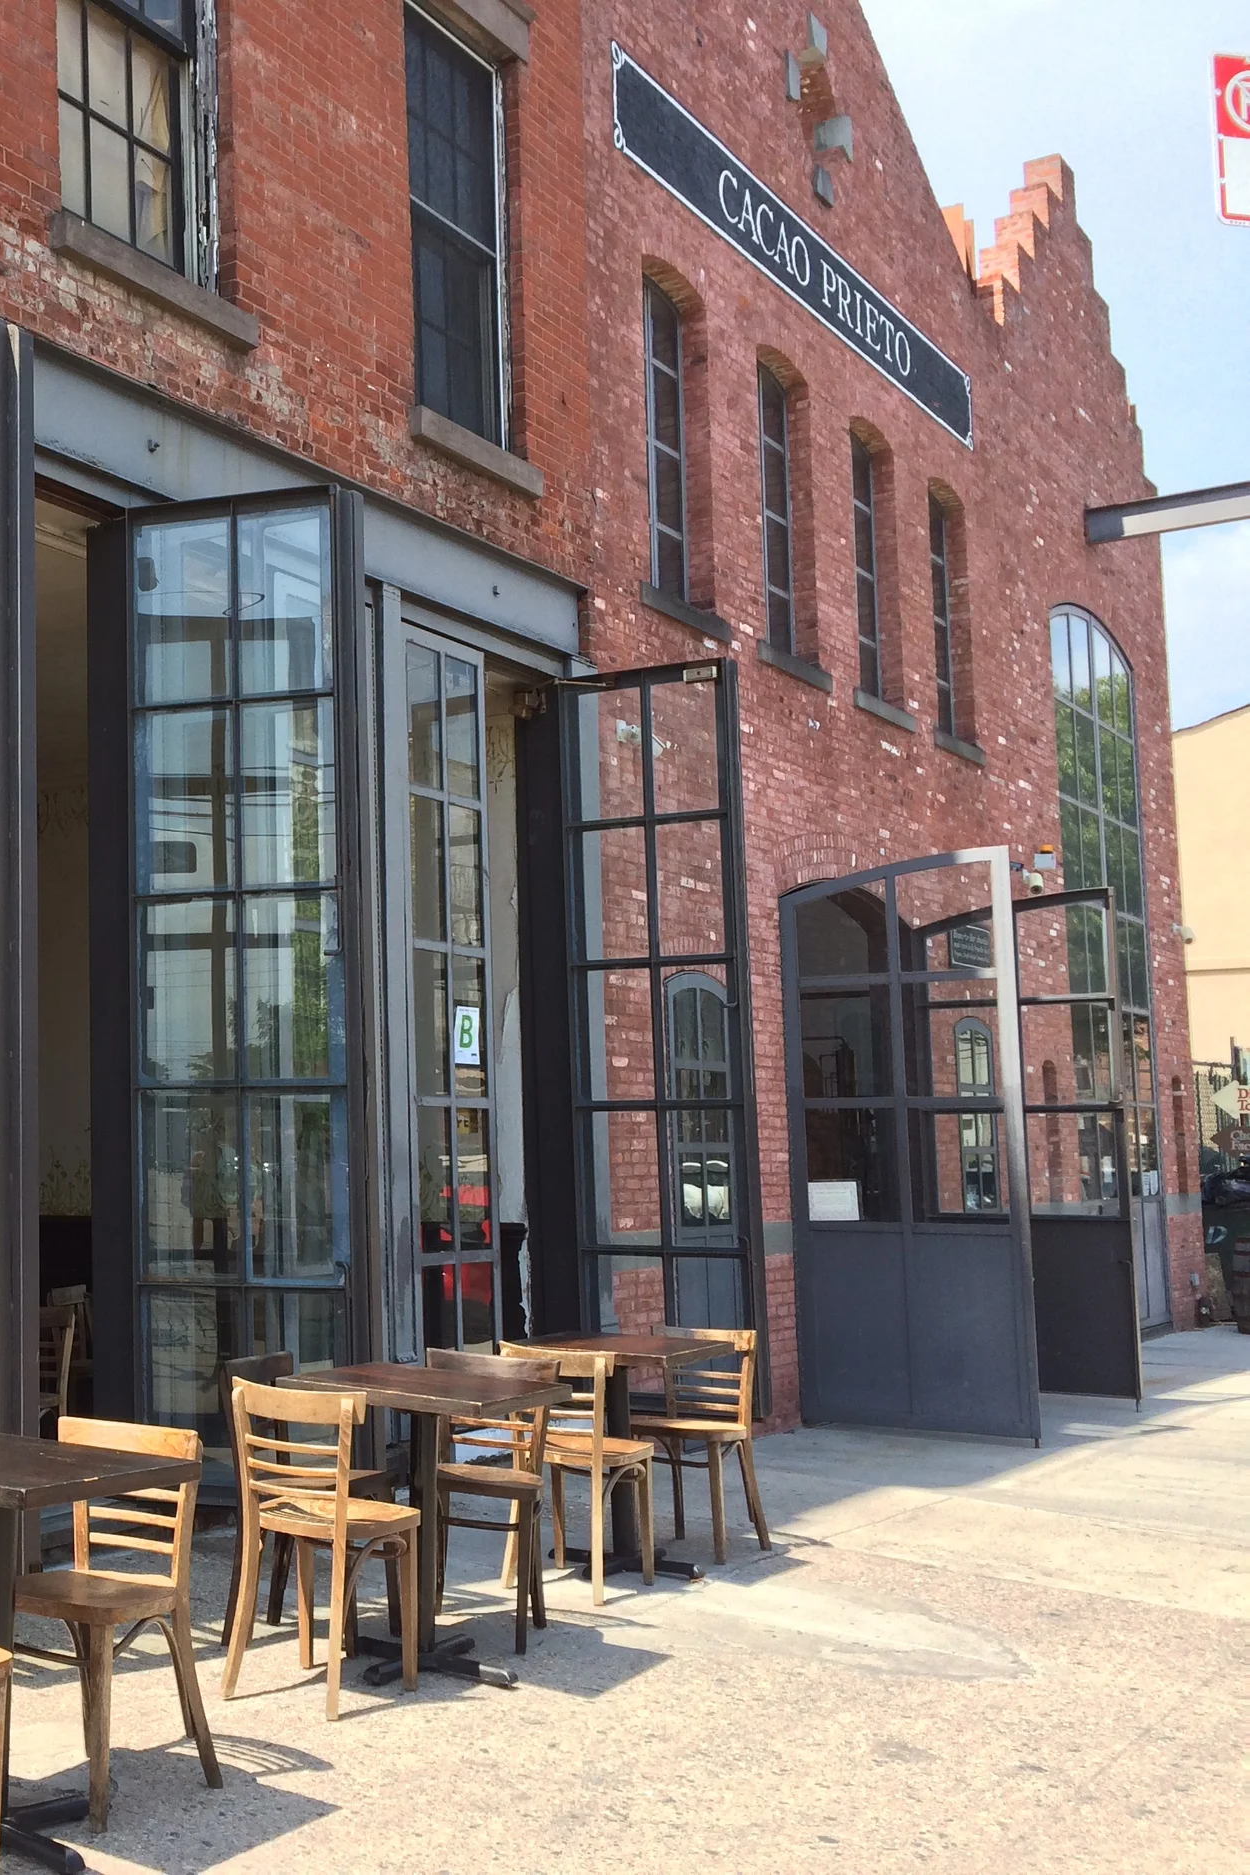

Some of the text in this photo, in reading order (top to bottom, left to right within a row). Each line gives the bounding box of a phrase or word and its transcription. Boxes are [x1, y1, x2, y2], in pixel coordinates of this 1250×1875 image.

[718, 169, 911, 377] CACAO PRIETO
[459, 1014, 473, 1048] B
